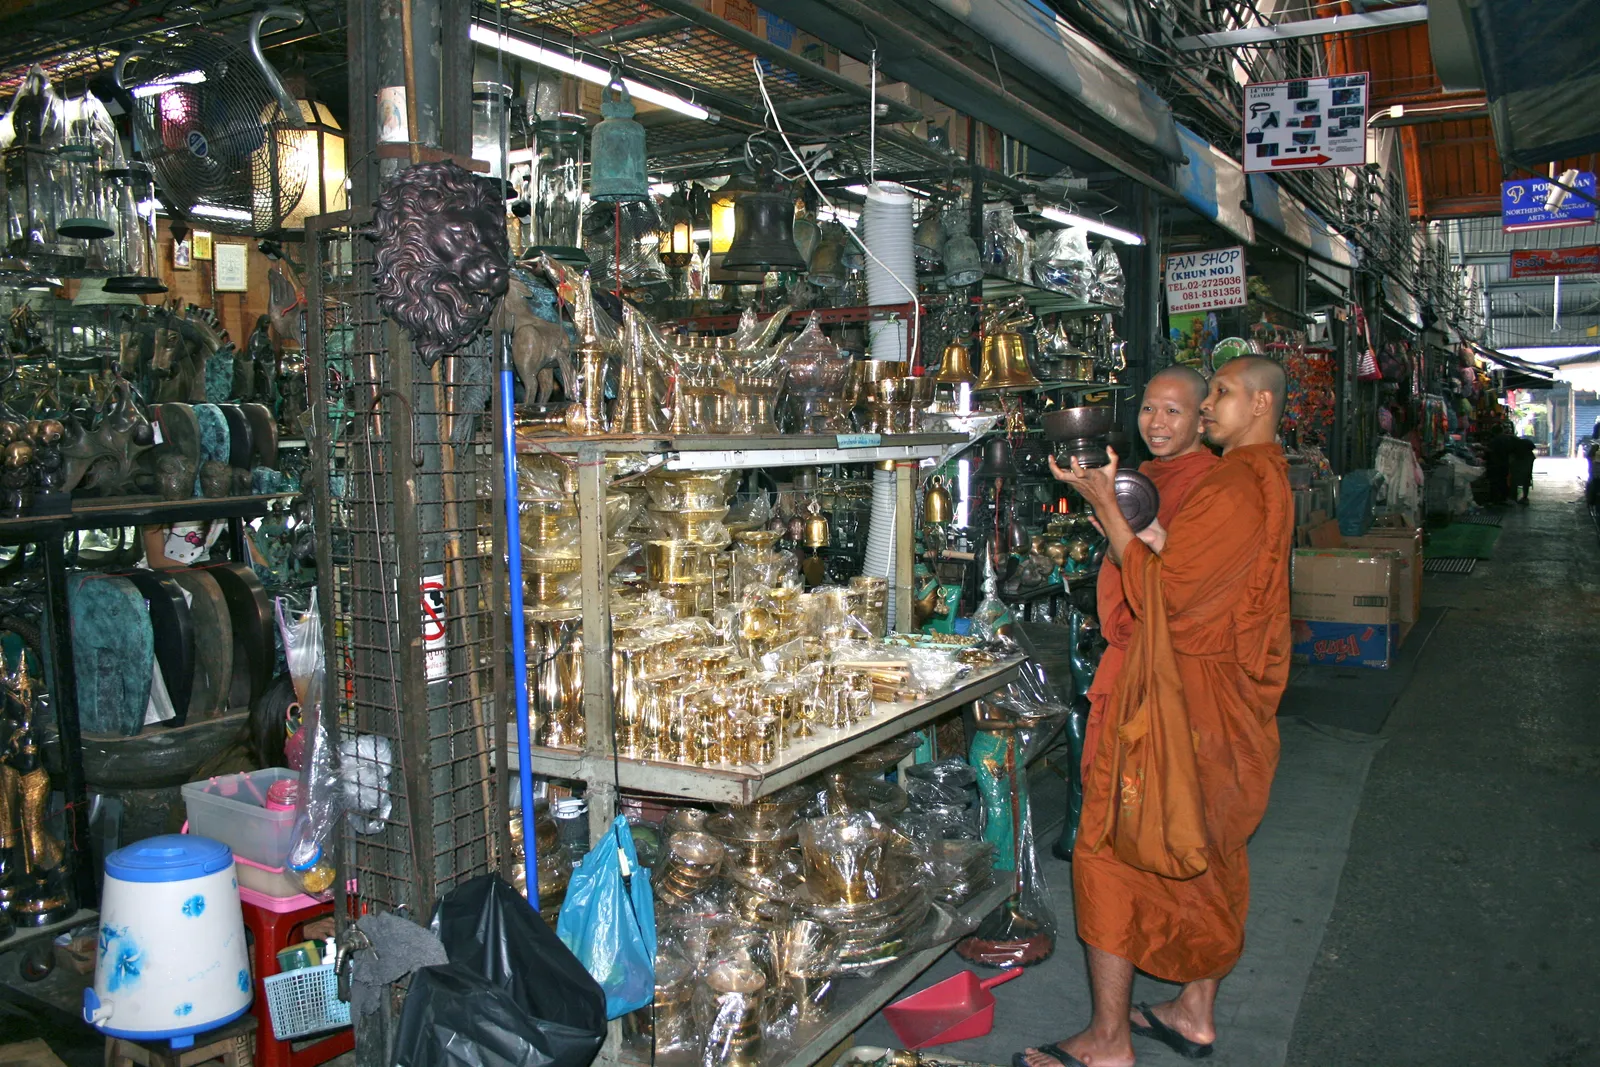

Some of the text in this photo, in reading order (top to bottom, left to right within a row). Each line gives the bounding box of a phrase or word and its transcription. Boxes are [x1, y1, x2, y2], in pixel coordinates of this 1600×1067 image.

[1505, 206, 1544, 216] NORTHERN
[1527, 213, 1545, 221] ARTS
[1167, 250, 1240, 271] FAN SHOP
[1171, 265, 1234, 281] (KHUN NOI)
[1182, 287, 1241, 301] 081-8181356
[1170, 302, 1200, 311] Section
[1229, 297, 1242, 305] 4/4
